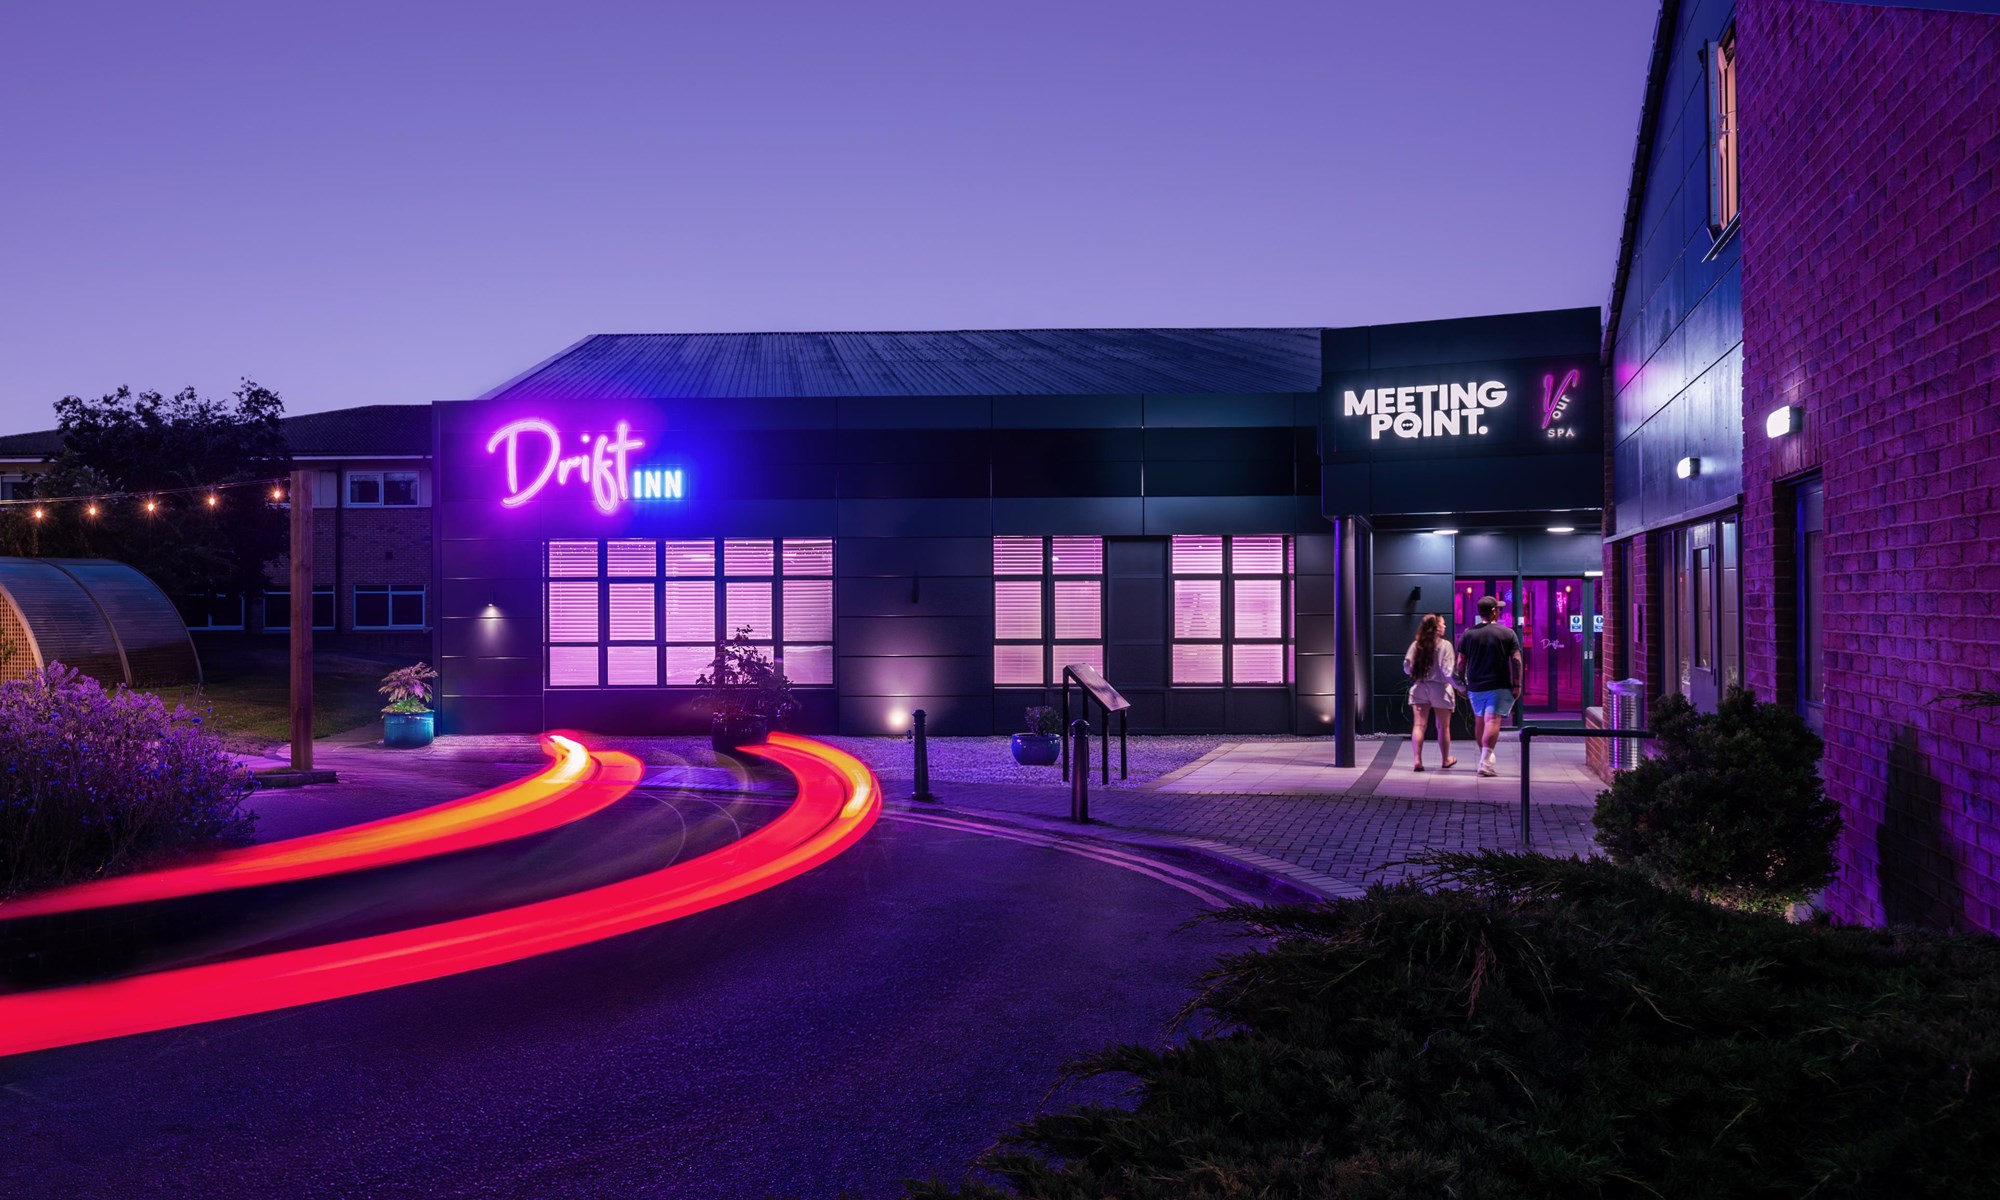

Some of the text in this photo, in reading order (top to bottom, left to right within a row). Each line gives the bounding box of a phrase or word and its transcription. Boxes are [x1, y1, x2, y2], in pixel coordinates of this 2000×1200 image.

[1344, 380, 1508, 416] MEETING
[1547, 427, 1576, 438] SPA
[486, 419, 683, 513] Drift INN
